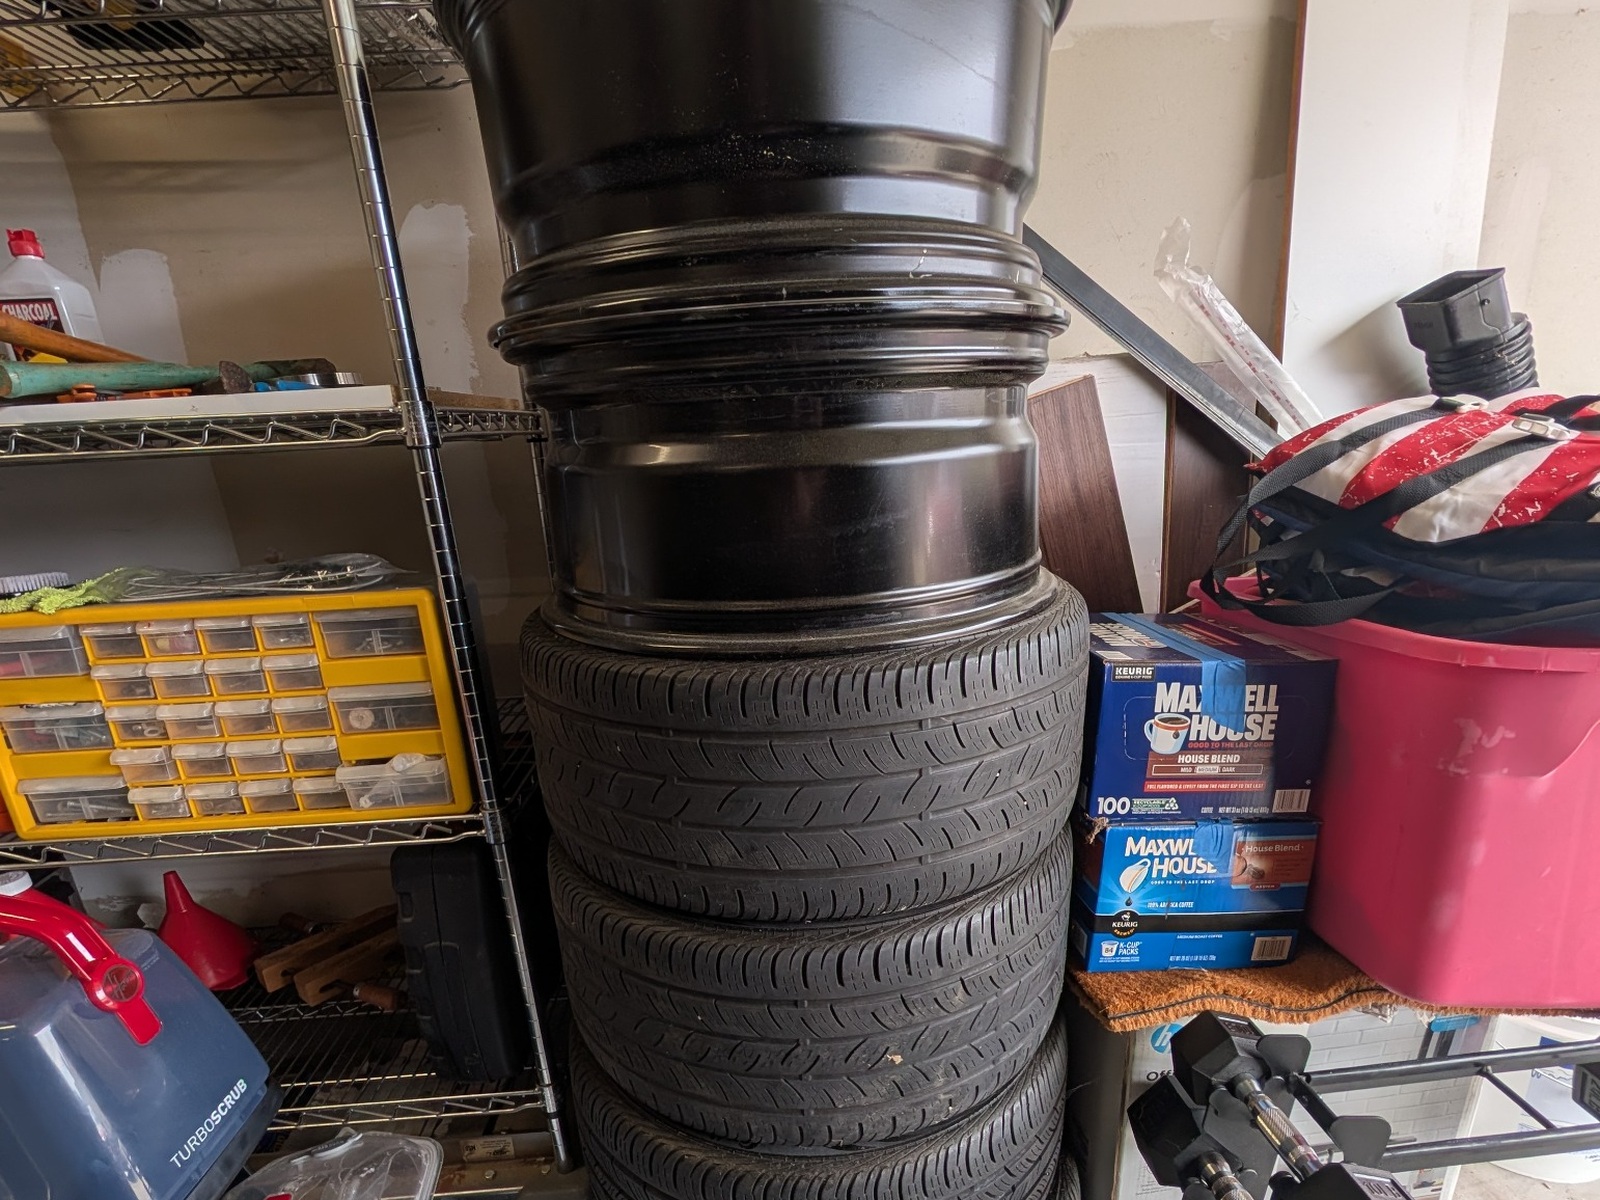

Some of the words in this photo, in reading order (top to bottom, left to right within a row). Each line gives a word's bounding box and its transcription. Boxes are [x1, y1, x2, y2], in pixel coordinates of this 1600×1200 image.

[1115, 667, 1154, 675] KEURIG
[1154, 682, 1279, 713] MAELL
[1188, 741, 1209, 749] GOOD
[1178, 754, 1209, 764] HOUSE
[1211, 754, 1240, 763] BLEND
[1098, 797, 1130, 814] 100
[1245, 845, 1273, 853] House
[1275, 844, 1300, 852] Blend
[170, 1079, 247, 1168] TURBOSCRUB
